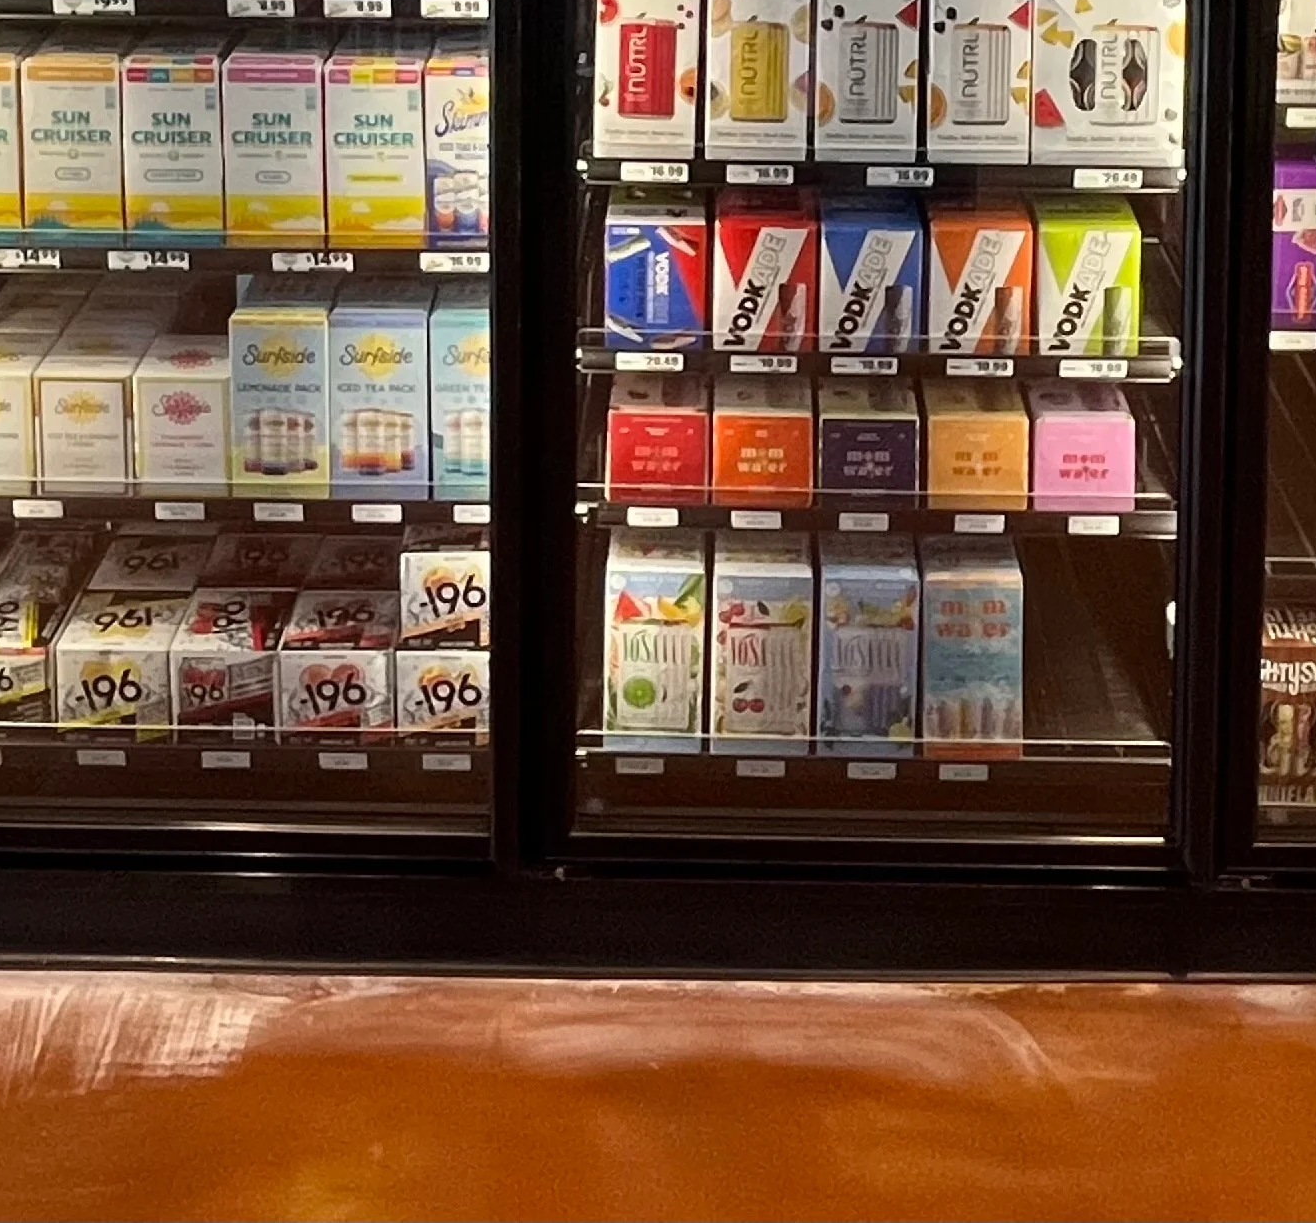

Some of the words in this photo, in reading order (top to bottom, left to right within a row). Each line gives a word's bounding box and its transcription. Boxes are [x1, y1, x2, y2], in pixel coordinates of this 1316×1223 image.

[51, 111, 90, 125] SUN
[151, 113, 190, 127] SUN
[252, 113, 291, 127] SUN
[354, 114, 393, 128] SUN
[31, 129, 111, 144] CRUISER
[132, 130, 211, 146] CRUISER
[232, 131, 312, 146] CRUISER
[333, 132, 413, 147] CRUISER
[242, 344, 316, 368] Surfside
[339, 344, 413, 368] Surfside
[237, 384, 292, 393] LEMONADE
[295, 384, 321, 393] PACK
[337, 384, 362, 393] ICED
[365, 384, 386, 393] TEA
[389, 384, 416, 393] PACK
[738, 447, 784, 459] mom
[1062, 453, 1106, 465] mom
[737, 459, 788, 475] water
[1058, 466, 1109, 481] water
